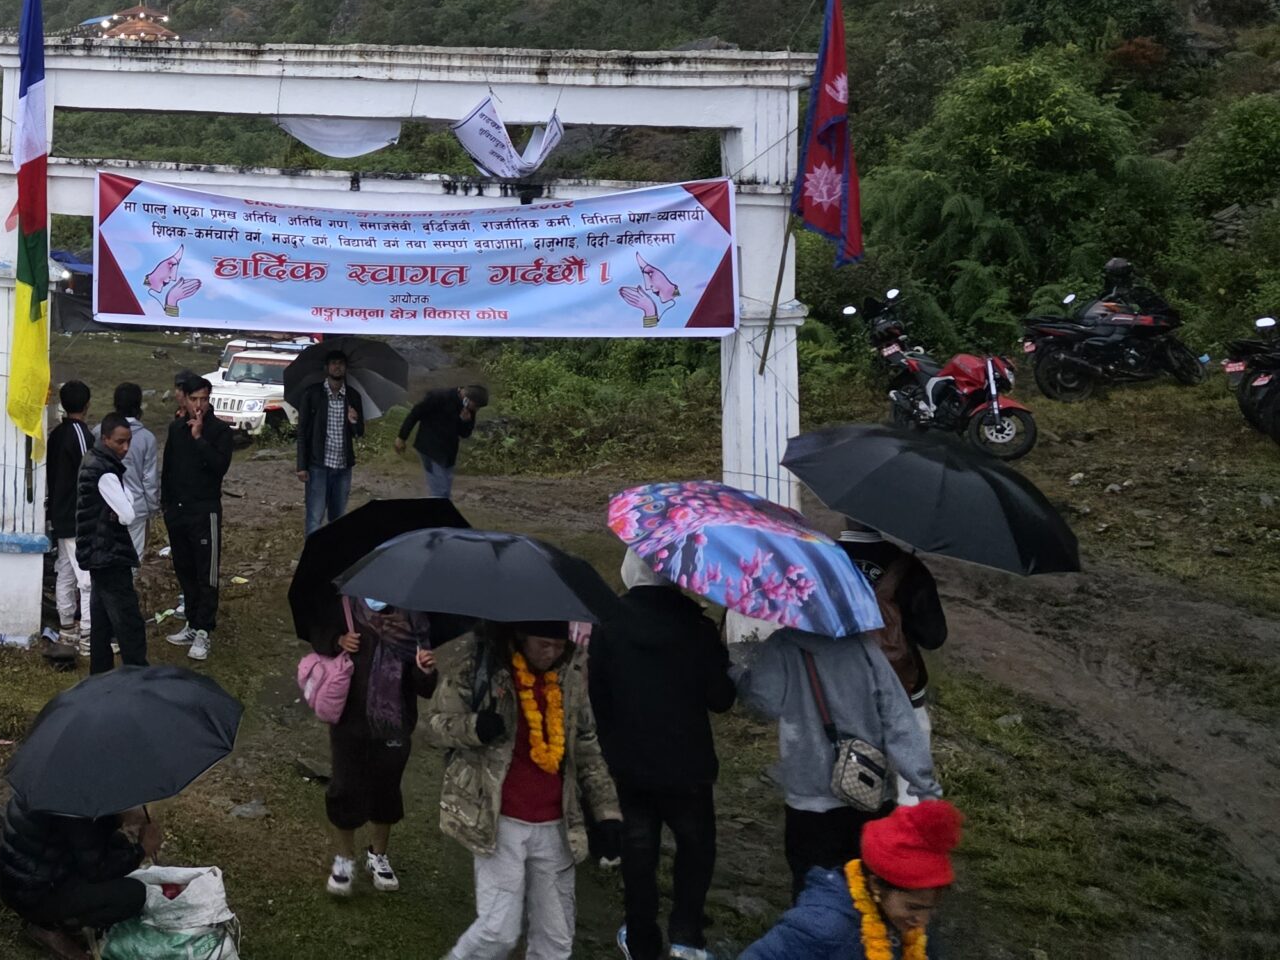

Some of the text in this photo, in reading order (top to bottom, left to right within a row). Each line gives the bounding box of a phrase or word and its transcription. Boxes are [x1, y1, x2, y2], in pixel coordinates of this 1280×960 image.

[123, 201, 137, 213] मा
[142, 203, 168, 219] पाल्नु
[172, 205, 205, 220] भएका
[210, 208, 238, 223] प्रमुख
[288, 214, 322, 228] अतिथि
[481, 216, 540, 232] राजनीतिक
[580, 212, 622, 225] विभिन्न
[272, 233, 306, 249] मजदुर
[338, 234, 377, 248] विद्यार्थी
[382, 237, 400, 249] वर्ग
[405, 240, 427, 249] तथा
[213, 251, 328, 282] हार्दिक
[346, 262, 471, 287] स्वागत
[388, 292, 431, 305] आयोजक
[310, 306, 510, 323] गङ्गाजमुना क्षेत्र विकास कोष
